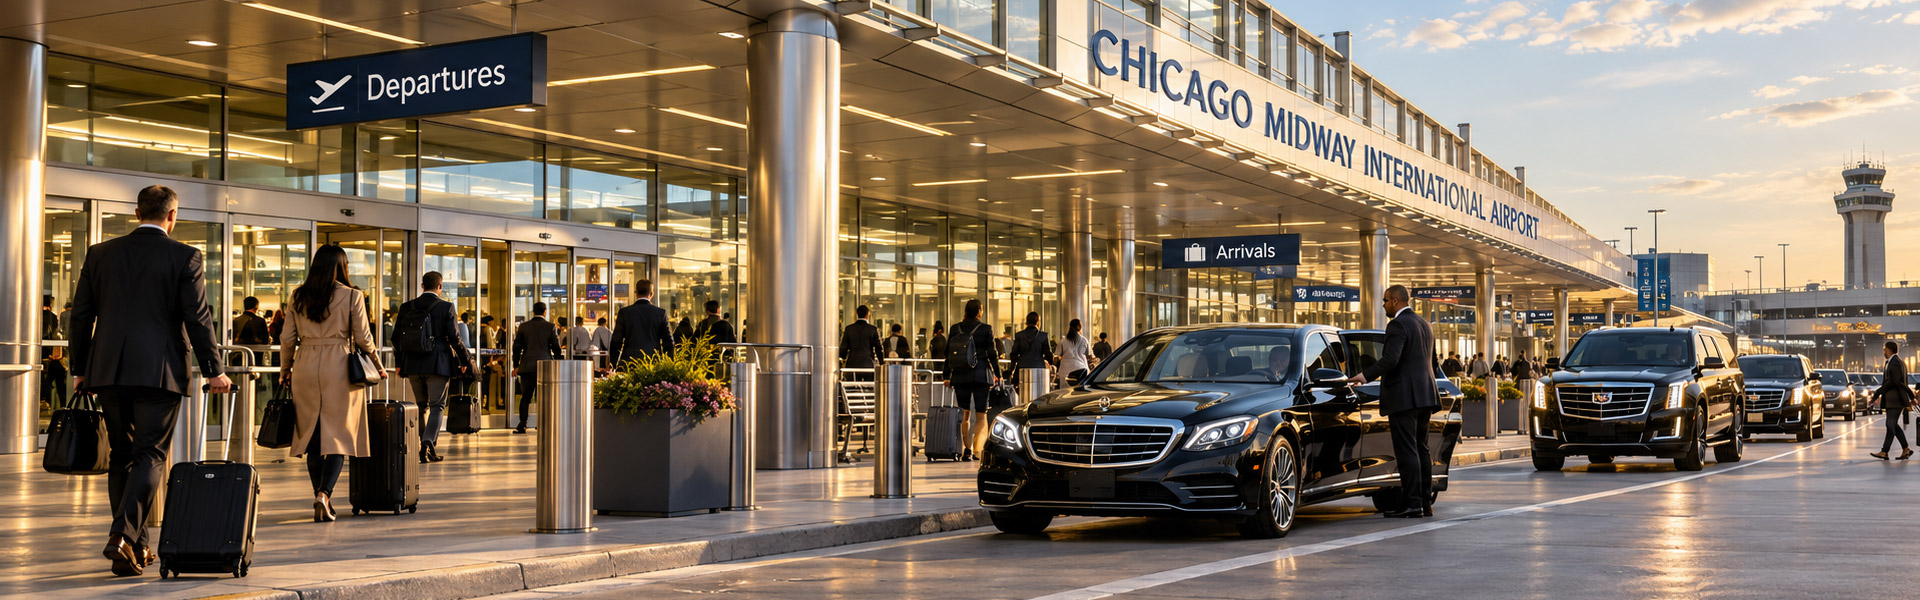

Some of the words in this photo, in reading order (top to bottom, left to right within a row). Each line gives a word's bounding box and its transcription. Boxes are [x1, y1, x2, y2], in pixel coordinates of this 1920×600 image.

[367, 64, 506, 105] Departures
[1092, 29, 1253, 129] CHICAGO
[1264, 102, 1355, 169] MIDWAY
[1364, 144, 1486, 221] INTERNATIONAL
[1490, 199, 1540, 241] AIRPORT
[1216, 242, 1276, 259] Arrivals
